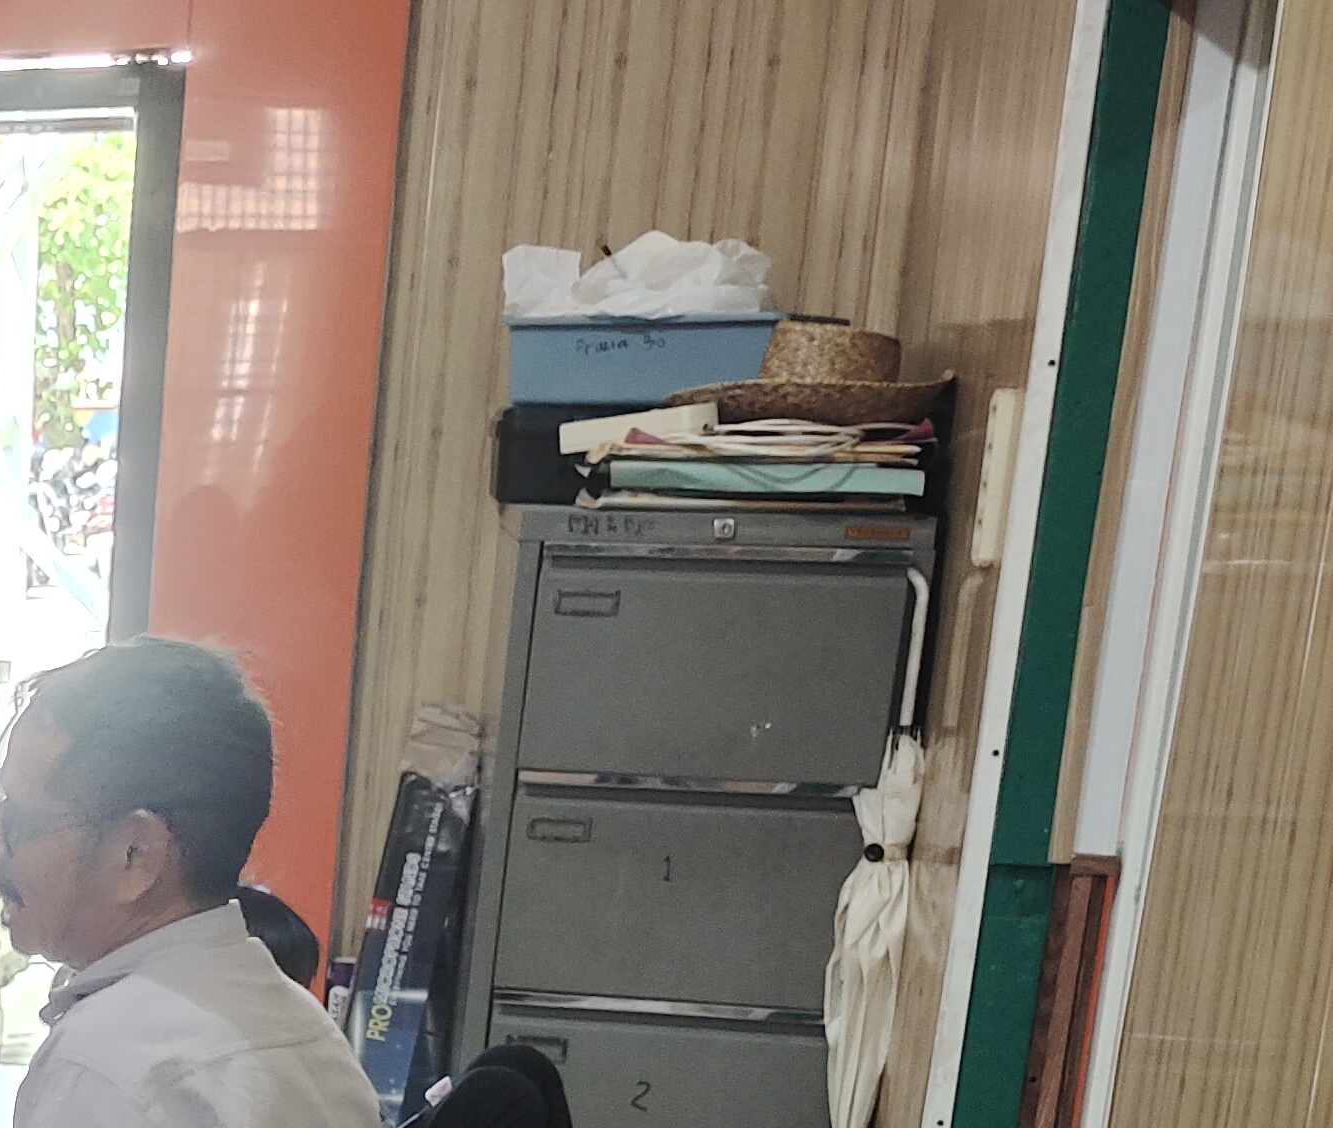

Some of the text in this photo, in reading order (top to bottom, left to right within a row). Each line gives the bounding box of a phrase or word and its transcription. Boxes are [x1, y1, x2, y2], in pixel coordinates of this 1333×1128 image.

[662, 855, 671, 882] 1
[365, 1003, 394, 1042] PRO
[629, 1080, 652, 1112] 2
